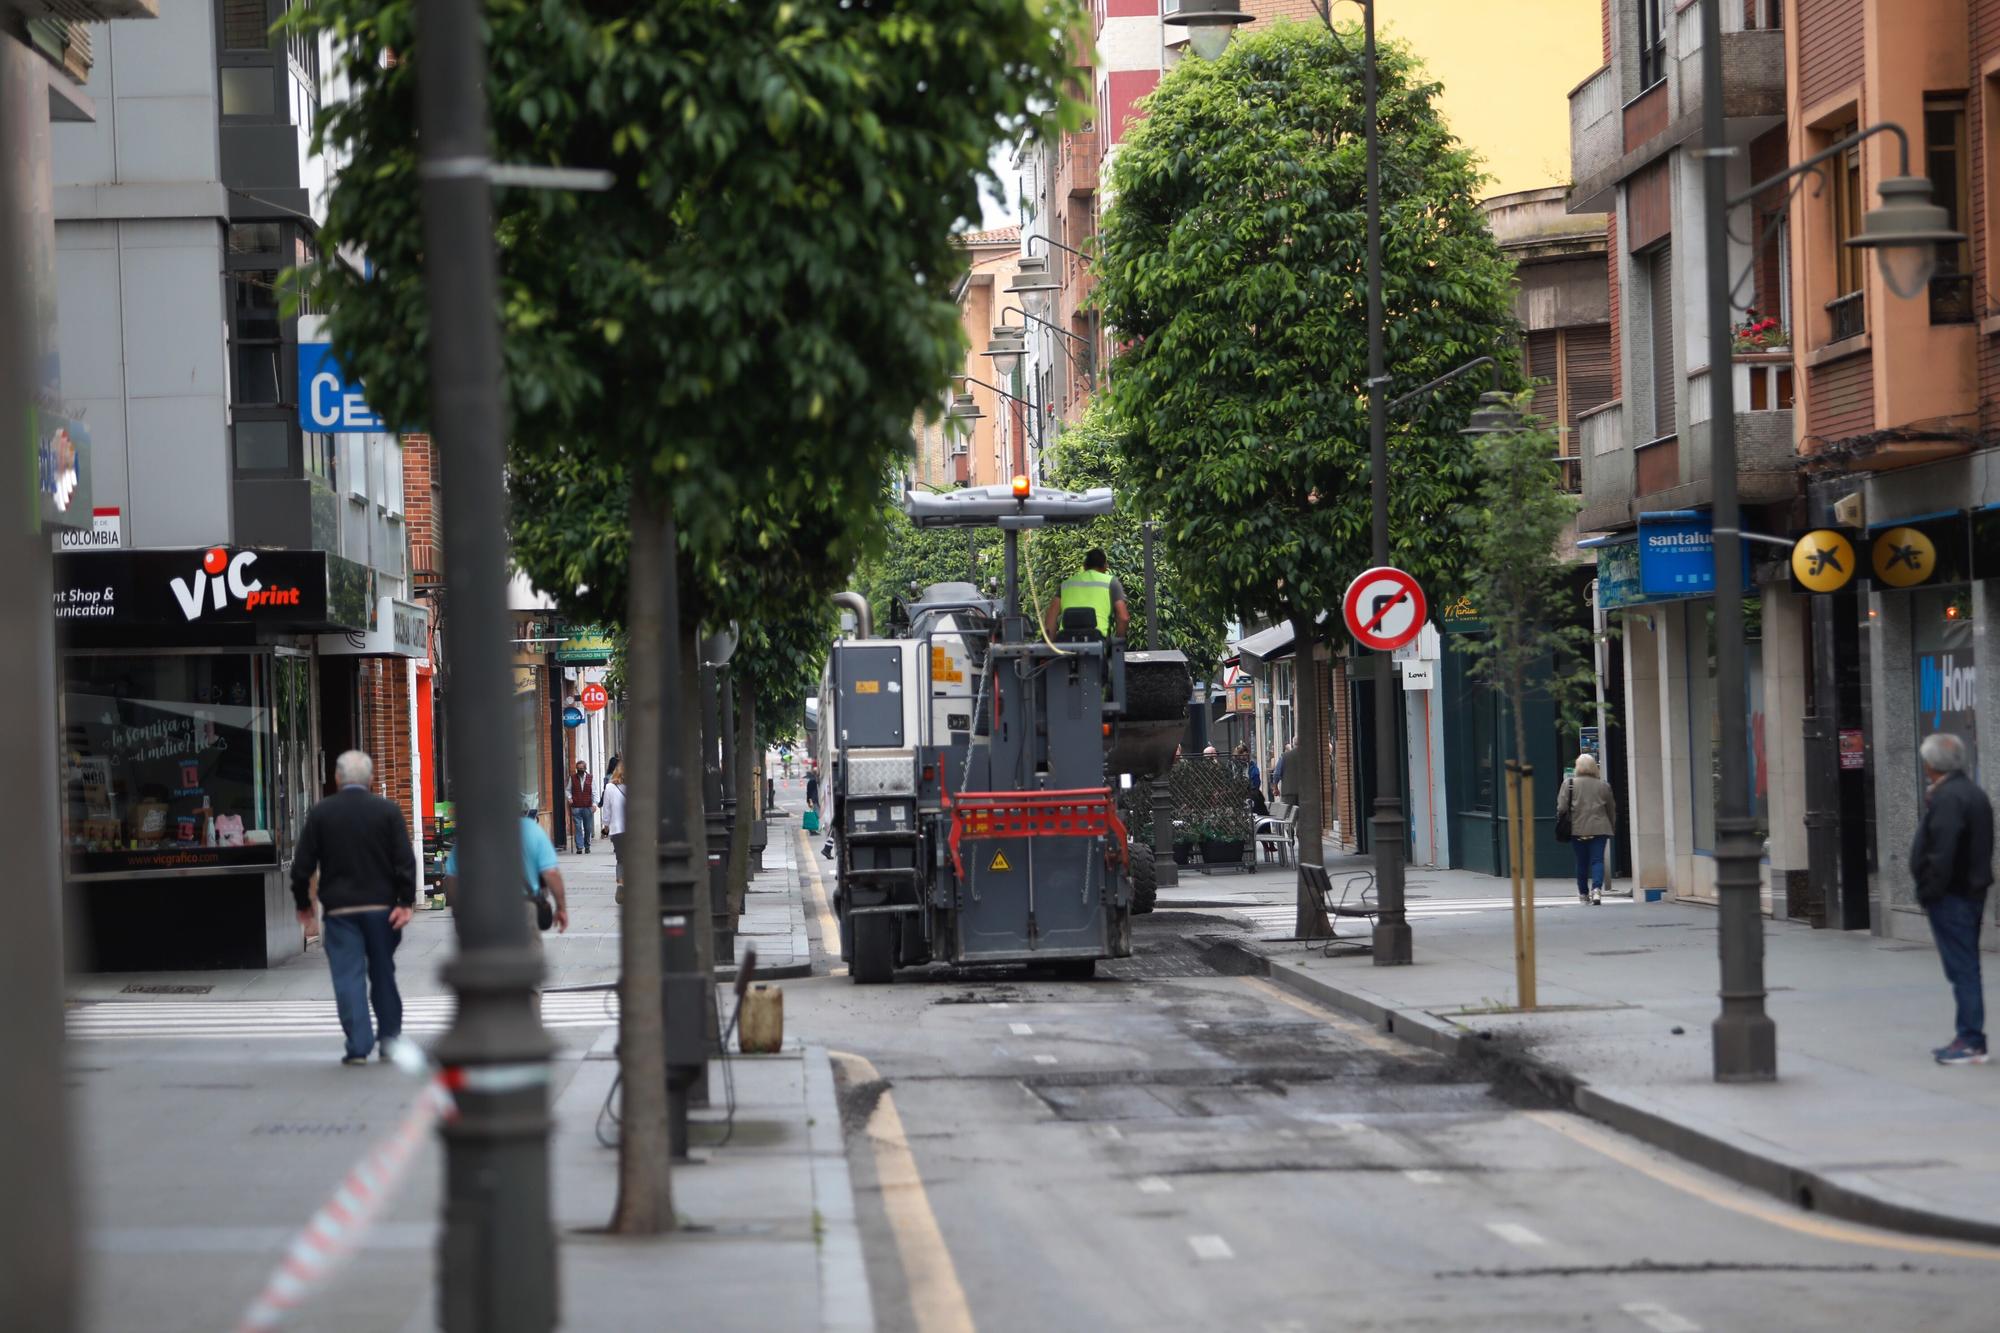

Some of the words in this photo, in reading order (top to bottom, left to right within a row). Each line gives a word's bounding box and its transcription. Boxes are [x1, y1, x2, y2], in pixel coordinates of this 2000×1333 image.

[311, 372, 385, 426] CE
[62, 531, 119, 545] COLOMBIA
[53, 591, 66, 602] nt
[69, 588, 101, 604] Shop
[103, 587, 114, 601] &
[246, 584, 300, 611] print
[54, 603, 115, 617] unication
[584, 687, 604, 701] ria
[1920, 654, 1976, 729] MyHom
[128, 851, 219, 866] www.vicgrafico.com
